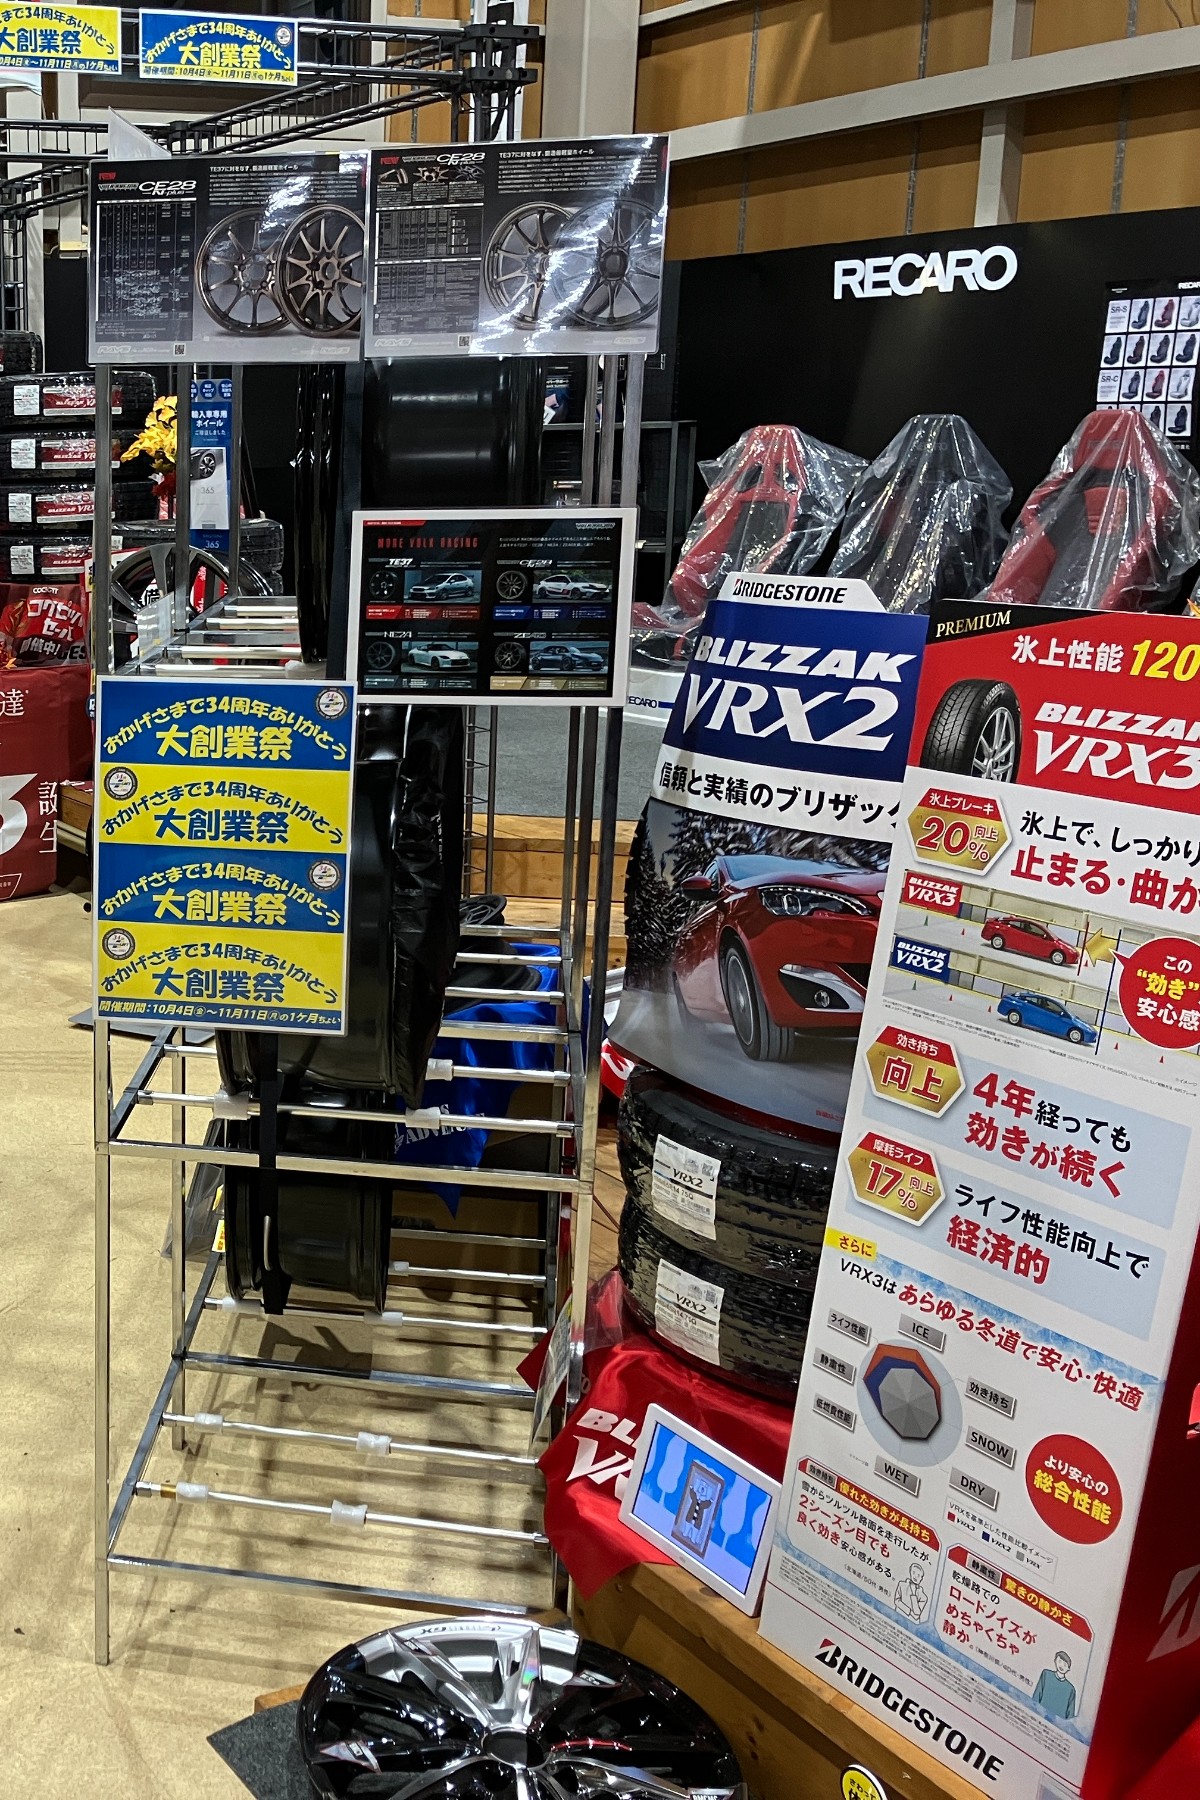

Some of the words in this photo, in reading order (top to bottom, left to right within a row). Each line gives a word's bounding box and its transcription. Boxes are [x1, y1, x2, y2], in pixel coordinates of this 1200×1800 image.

[145, 22, 293, 70] おかげさまで34周年ありがとう
[179, 41, 262, 69] 大創業祭
[139, 180, 197, 192] CE28
[833, 244, 1018, 300] RECARO
[196, 419, 224, 427] ホイール
[200, 486, 215, 494] 365
[204, 540, 220, 549] 365
[388, 558, 414, 567] TE37
[732, 577, 848, 604] BRIDGESTONE
[936, 609, 1012, 638] PREMIUM
[698, 635, 918, 683] BLIZZAK
[1011, 634, 1125, 674] 氷上性能
[681, 672, 900, 752] VRX2
[1034, 701, 1200, 742] BLIZZA
[102, 696, 348, 761] おかげさまで34周年ありがとう
[156, 724, 293, 762] 大創業祭
[1033, 729, 1200, 790] VRX3
[101, 781, 344, 844] おかげさまで34周年ありがとう
[928, 792, 995, 815] 氷上ブレーキ
[154, 807, 290, 845] 大創業祭
[973, 825, 999, 841] 向上
[100, 862, 342, 926] おかげさまで34周年ありがとう
[906, 885, 956, 907] VRX3
[908, 876, 960, 894] BLIZZAK
[152, 887, 288, 926] 大創業祭
[895, 950, 944, 974] VRX2
[896, 941, 948, 960] BLIZZAK
[1163, 955, 1193, 974] この
[100, 942, 338, 1004] おかげさまで34周年ありがとう
[152, 966, 286, 1004] 大創業祭
[896, 1032, 939, 1056] 効き持ち
[880, 1055, 944, 1103] 向上
[972, 1072, 1132, 1153] 4年経っても
[872, 1138, 925, 1166] 摩耗ライフ
[964, 1111, 1126, 1200] 効きが続く
[672, 1167, 703, 1188] VRX2
[909, 1176, 935, 1196] 向上
[838, 1235, 874, 1258] さらに
[954, 1183, 1151, 1280] ライフ性能向上で
[945, 1214, 1052, 1286] 経済的
[675, 1293, 707, 1315] VRX2
[829, 1311, 867, 1339] ライフ性能
[911, 1322, 930, 1340] ICE
[819, 1354, 847, 1376] 静粛性
[816, 1397, 853, 1426] 低燃費性能
[969, 1382, 1011, 1410] 効き持ち
[970, 1430, 1010, 1459] SNOW
[808, 1463, 836, 1485] 効き持ち
[883, 1463, 909, 1484] WET
[960, 1475, 987, 1496] DRY
[1044, 1454, 1110, 1496] より安心の
[838, 1480, 931, 1544] 優れた効きが長持ち
[1033, 1469, 1113, 1525] 総合性能
[798, 1494, 891, 1559] 2シーズン目でも
[956, 1517, 976, 1532] VRX3
[990, 1536, 1012, 1553] VRX2
[952, 1570, 1000, 1605] 乾燥路での
[1005, 1577, 1073, 1627] 驚きの静かさ
[946, 1603, 1020, 1655] めちゃくちゃ
[949, 1585, 1038, 1645] ロードノイズが
[813, 1637, 1005, 1782] BRIDGESTONE
